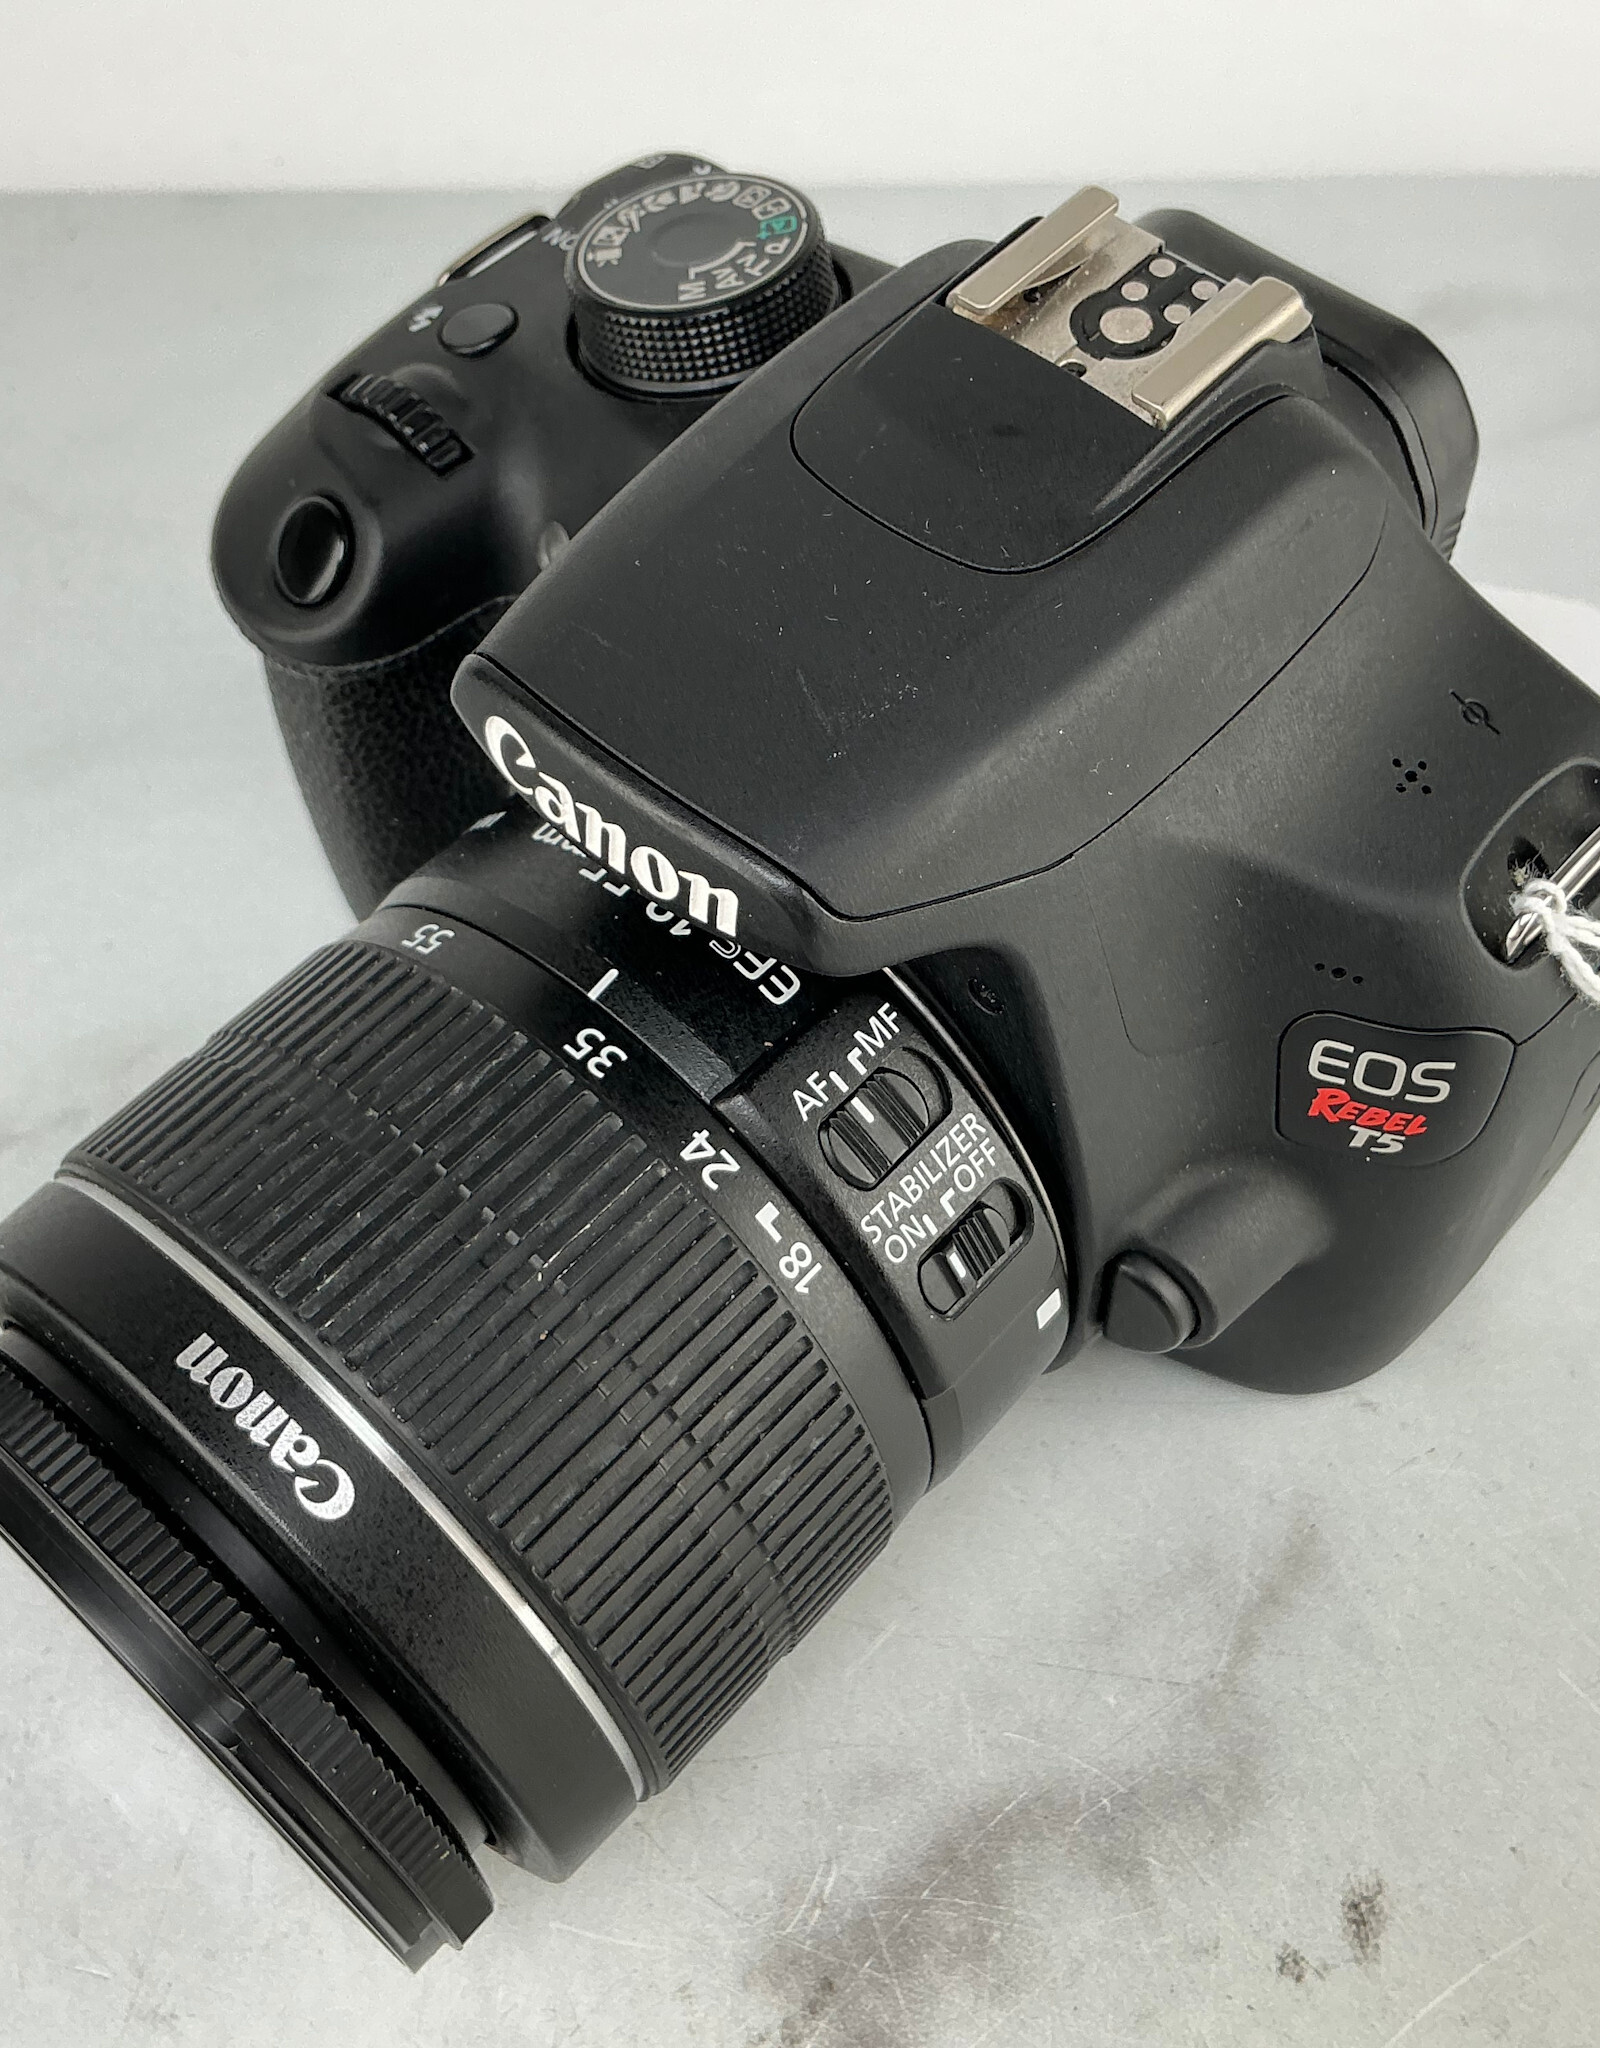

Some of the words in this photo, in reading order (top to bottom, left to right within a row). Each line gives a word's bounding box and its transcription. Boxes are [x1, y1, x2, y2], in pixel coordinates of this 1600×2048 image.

[764, 237, 792, 254] P
[677, 280, 707, 301] M
[484, 715, 739, 938] Canon
[401, 923, 455, 955] 55
[562, 1027, 628, 1079] 35
[792, 1070, 830, 1122] AF
[853, 1002, 901, 1057] MF
[1308, 1038, 1457, 1104] EOS
[679, 1128, 741, 1191] 24
[1348, 1124, 1406, 1154] T5
[860, 1112, 987, 1245] STABILIZER
[884, 1213, 928, 1263] ON
[953, 1136, 996, 1193] OFF
[778, 1241, 823, 1295] 18
[175, 1332, 356, 1521] Canon
